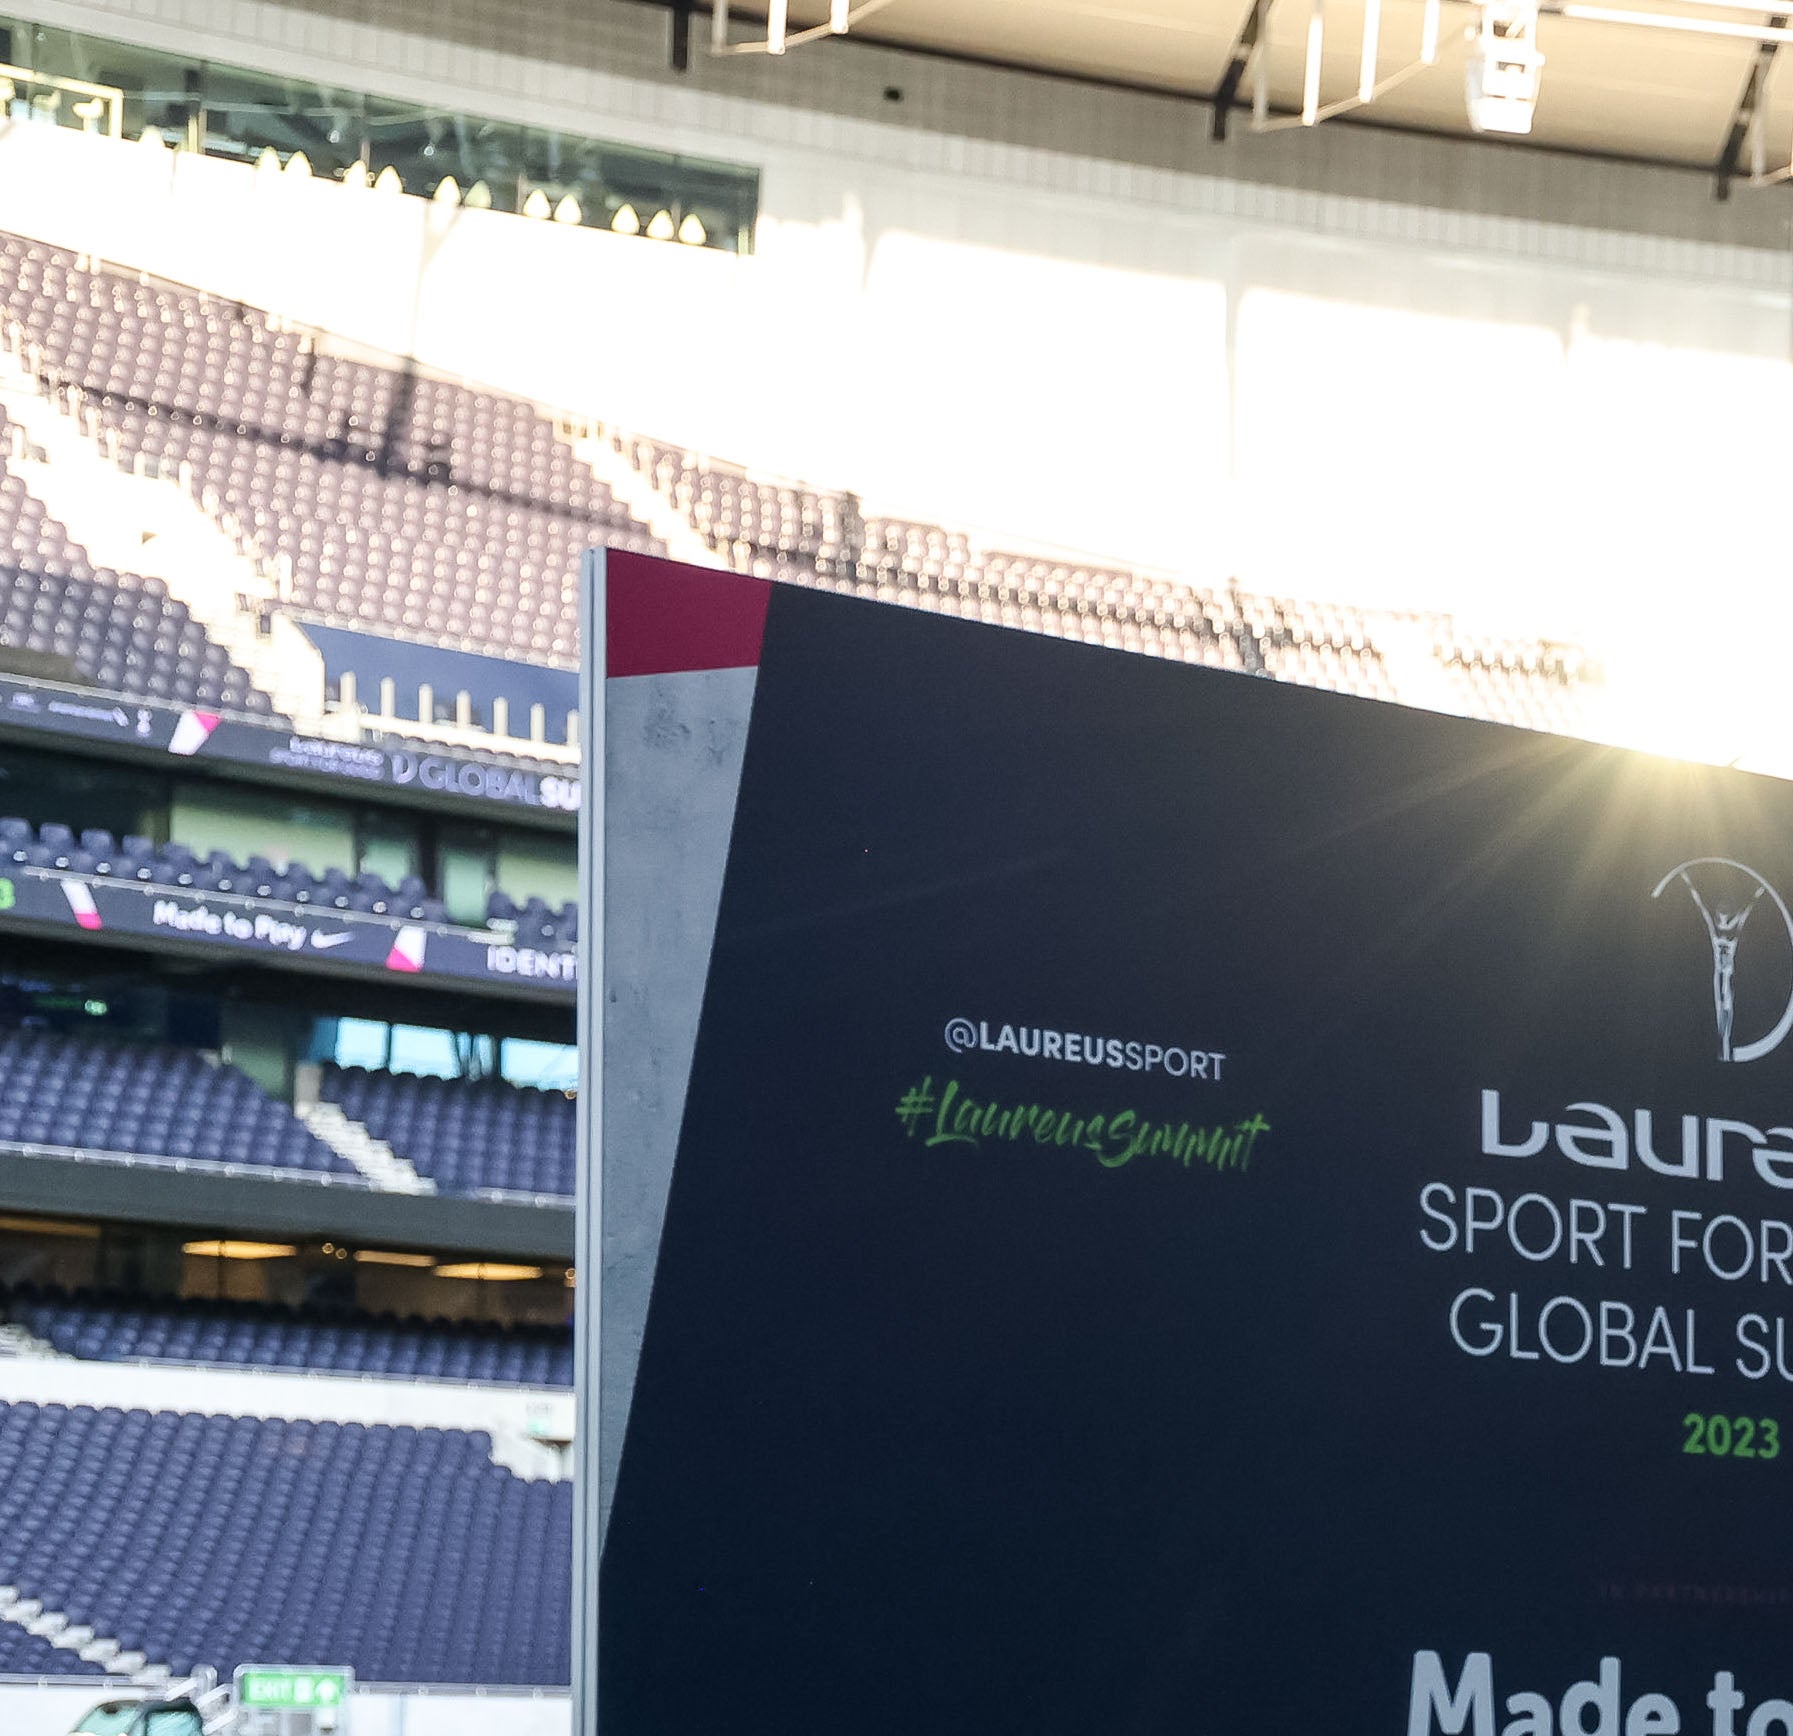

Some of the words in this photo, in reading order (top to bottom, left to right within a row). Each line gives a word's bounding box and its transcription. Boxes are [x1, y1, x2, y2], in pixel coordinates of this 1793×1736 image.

[419, 755, 541, 805] GLOBAL
[153, 900, 222, 935] Made
[223, 911, 253, 940] to
[944, 1017, 1226, 1081] @LAUREUSSPORT
[1419, 1182, 1648, 1269] SPORT
[1449, 1287, 1715, 1375] GLOBAL
[1682, 1412, 1781, 1460] 2023
